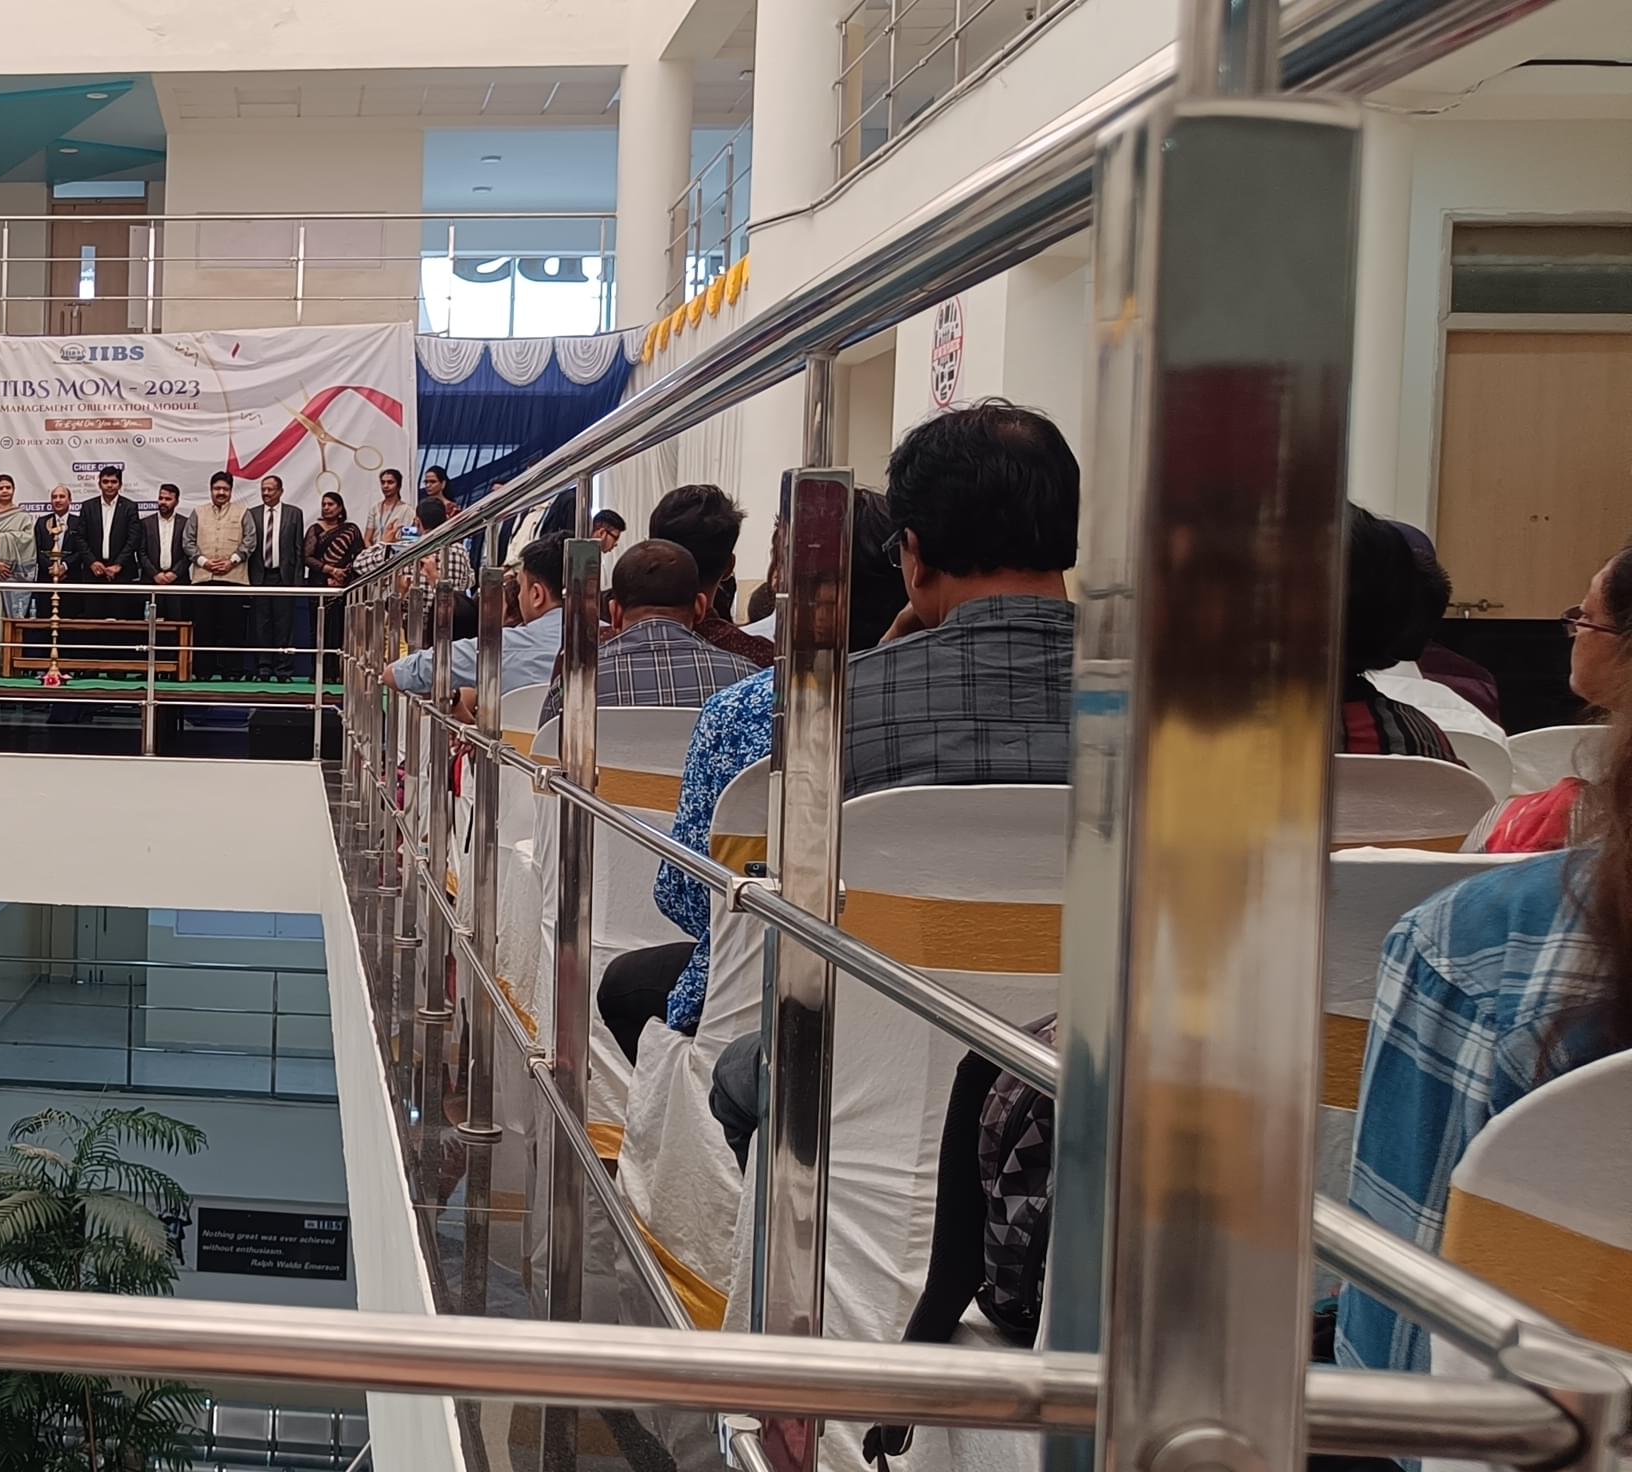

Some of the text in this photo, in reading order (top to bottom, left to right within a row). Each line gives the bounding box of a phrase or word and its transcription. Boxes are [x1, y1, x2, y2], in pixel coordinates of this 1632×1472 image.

[89, 345, 144, 361] IIBS
[0, 379, 51, 399] IIBS
[55, 378, 127, 401] MOM
[144, 380, 201, 398] 2023
[74, 463, 97, 471] CHIEF
[202, 1230, 235, 1241] Nothing
[237, 1232, 258, 1241] great
[299, 1236, 336, 1245] achieved
[202, 1243, 234, 1253] without
[250, 1258, 340, 1271] Ralph Waldo Emerson
